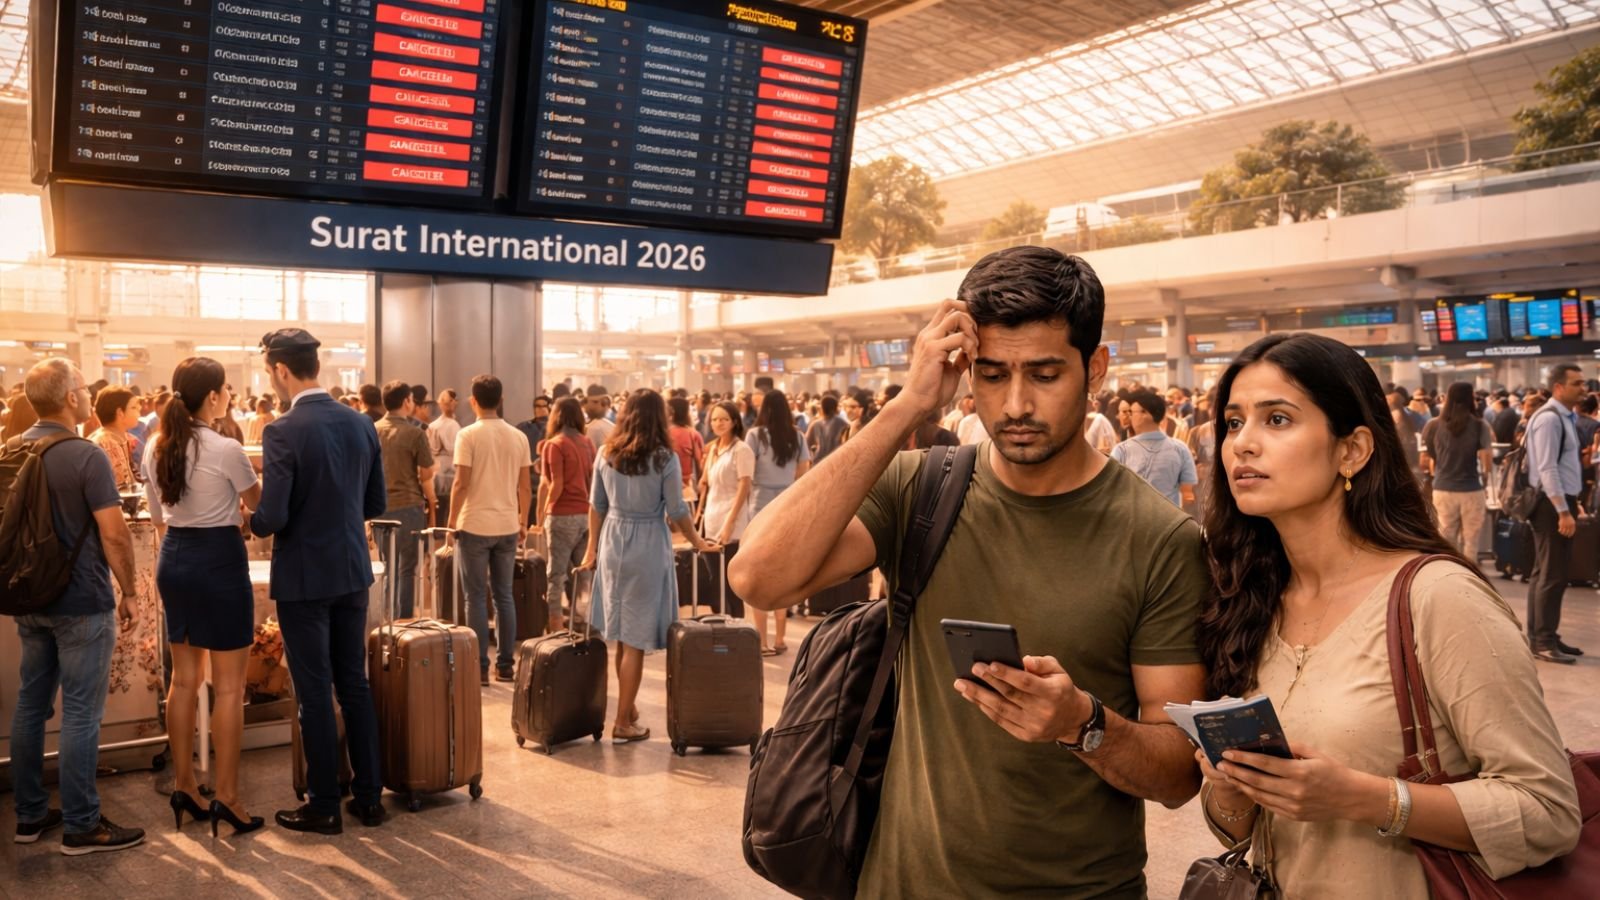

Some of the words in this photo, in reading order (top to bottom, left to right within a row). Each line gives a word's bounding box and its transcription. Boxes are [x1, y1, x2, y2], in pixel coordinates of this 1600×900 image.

[310, 216, 408, 252] Surat
[420, 224, 627, 267] International
[637, 241, 706, 272] 2026
